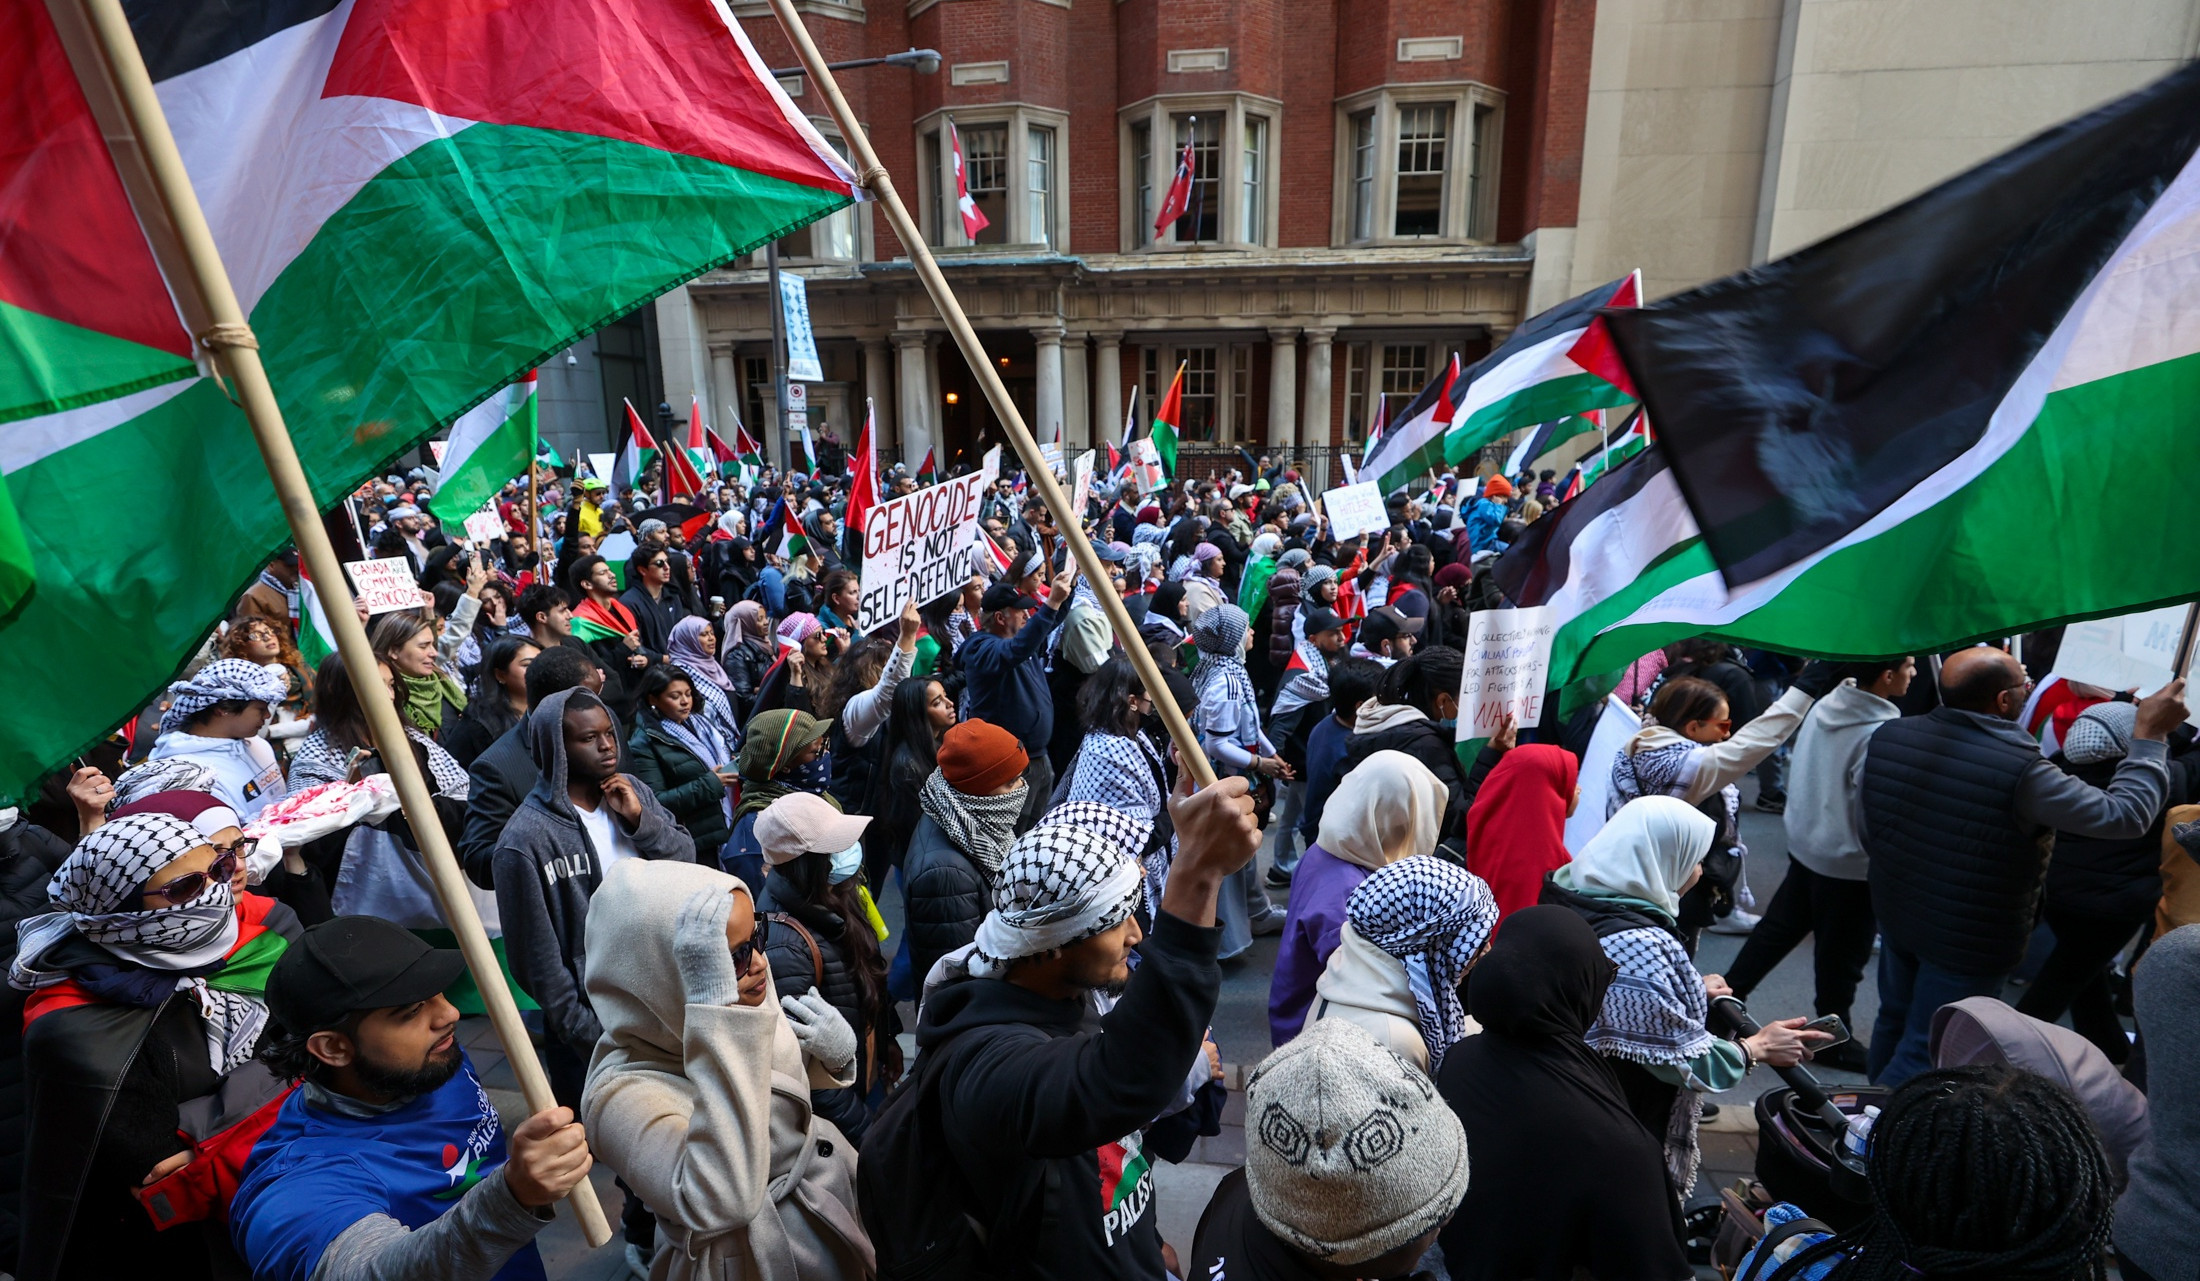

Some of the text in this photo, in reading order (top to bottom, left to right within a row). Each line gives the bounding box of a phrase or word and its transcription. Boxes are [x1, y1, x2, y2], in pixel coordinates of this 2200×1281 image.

[864, 474, 981, 559] GENOCIDE
[1339, 499, 1374, 516] HITLER
[898, 523, 960, 574] IS NOT
[352, 562, 391, 577] CANADA
[359, 576, 404, 592] COMPLICIT
[860, 544, 973, 631] SELF-DEFENCE
[365, 588, 421, 607] GENOCIDE
[1465, 667, 1481, 679] FOR
[1463, 682, 1480, 695] LED
[1525, 677, 1533, 689] A
[543, 852, 592, 886] HOLLI
[467, 1127, 479, 1147] RUN
[476, 1113, 489, 1132] FOR
